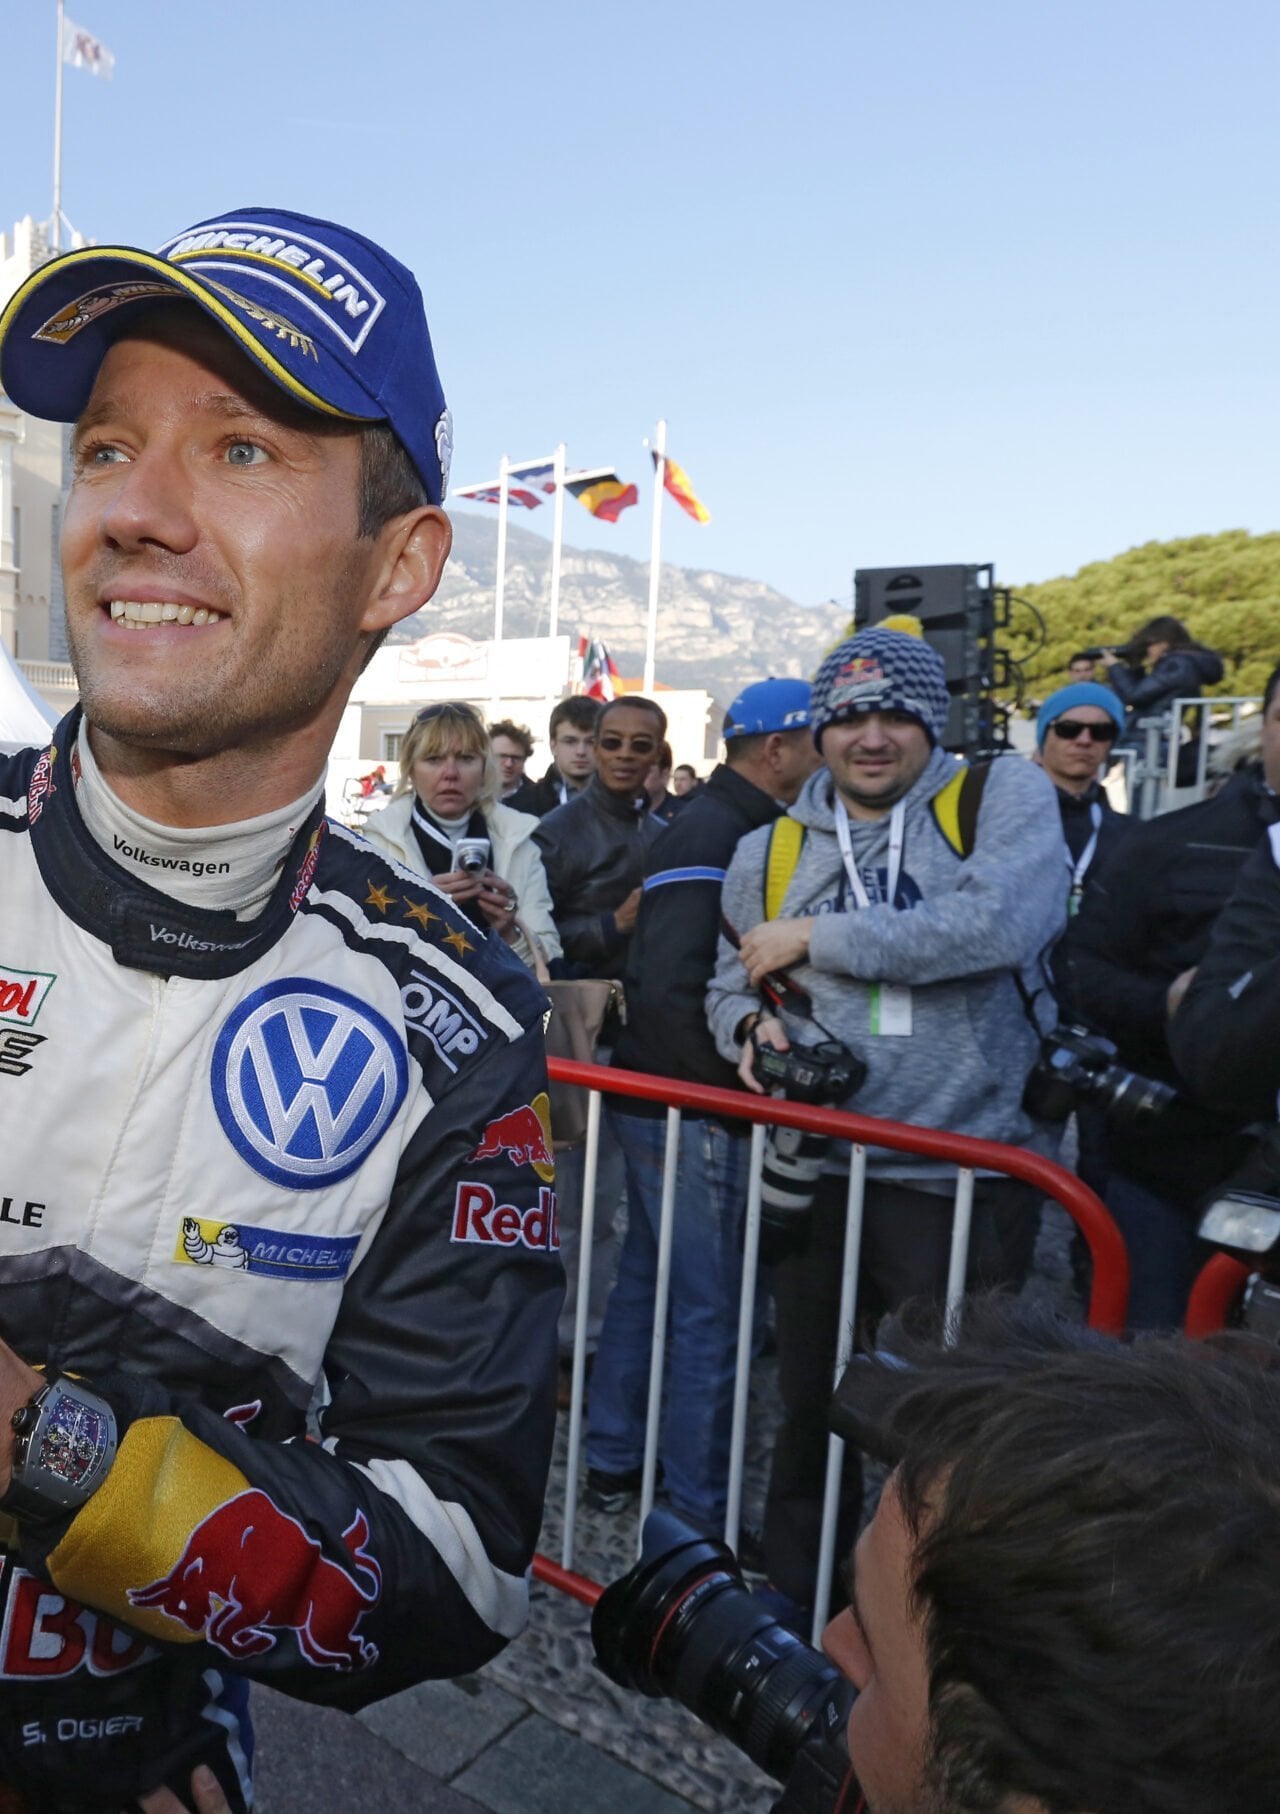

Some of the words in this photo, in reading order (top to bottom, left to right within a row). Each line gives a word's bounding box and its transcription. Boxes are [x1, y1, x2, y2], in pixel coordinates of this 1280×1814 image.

[167, 231, 369, 318] MICHELIN
[113, 834, 230, 877] Volkswagen
[400, 982, 479, 1055] OMP
[23, 1722, 47, 1746] S.
[57, 1716, 144, 1741] OGIER
